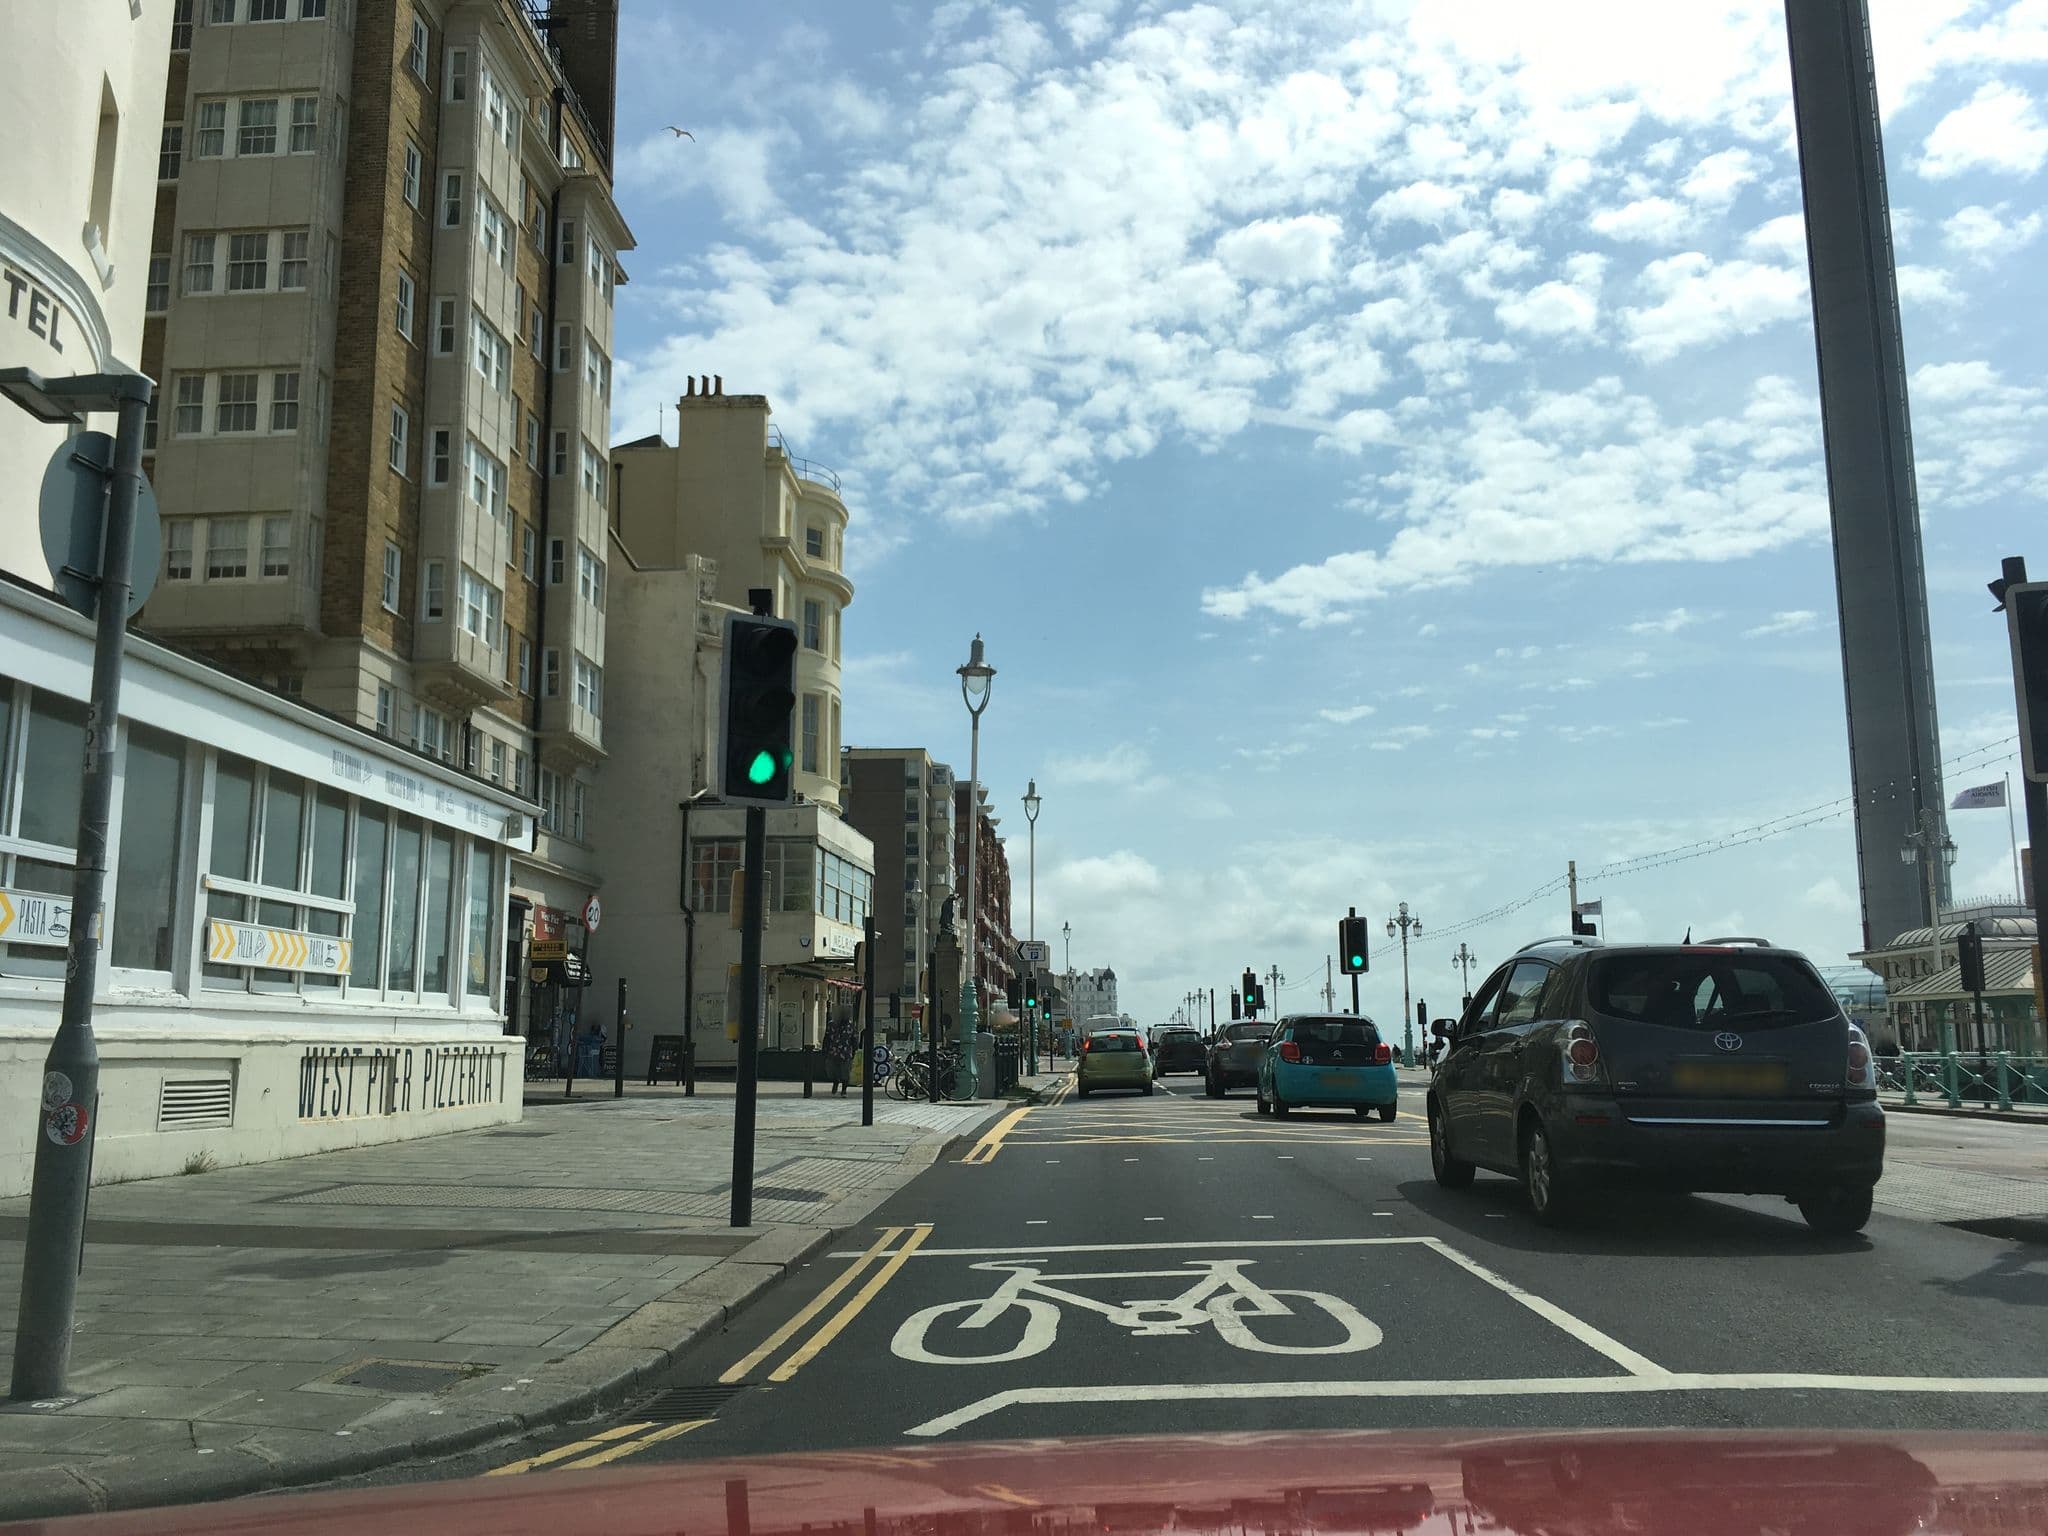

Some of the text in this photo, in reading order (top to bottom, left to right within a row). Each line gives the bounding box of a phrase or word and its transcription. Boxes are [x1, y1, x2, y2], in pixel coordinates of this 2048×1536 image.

[18, 898, 47, 936] PASTA
[588, 906, 599, 923] 20
[237, 929, 254, 959] PIZZA
[298, 1046, 494, 1118] WEST PIER PIZZERIA
